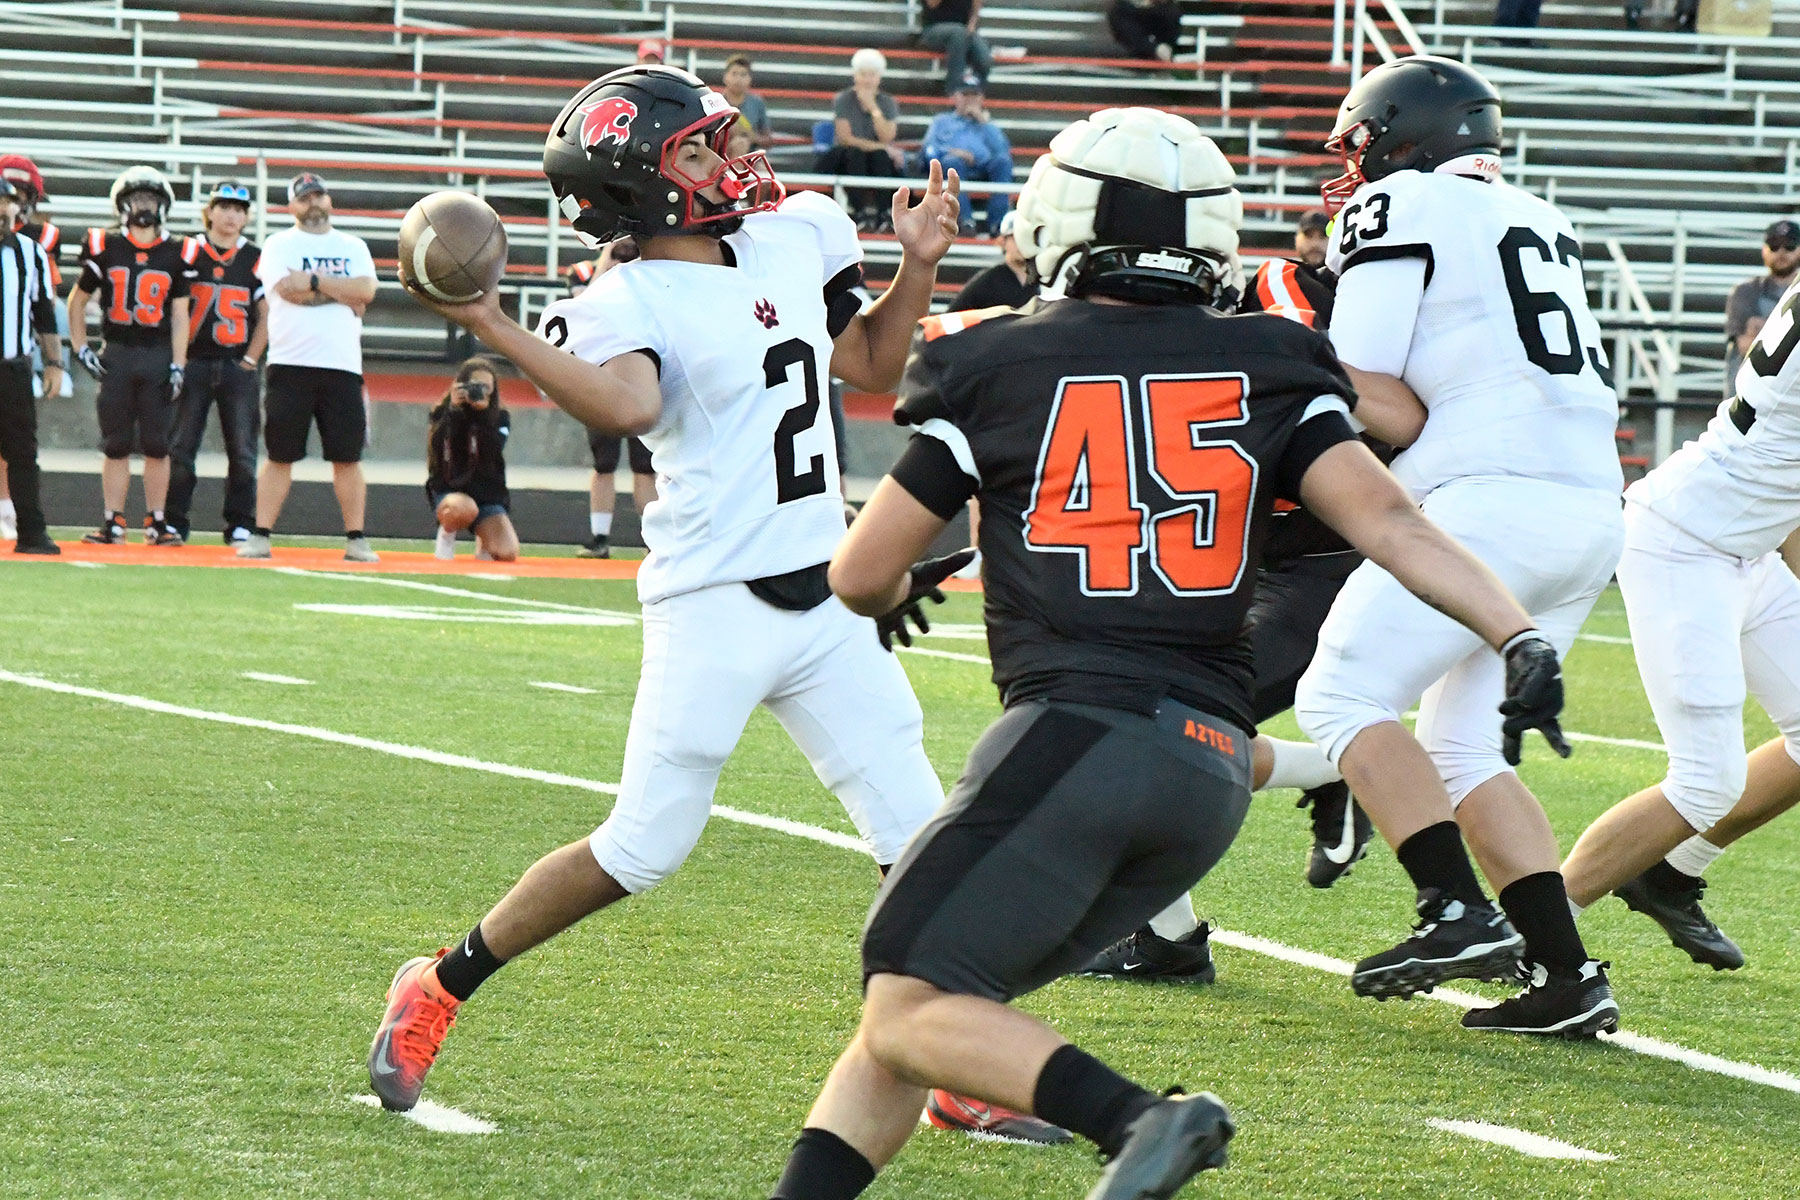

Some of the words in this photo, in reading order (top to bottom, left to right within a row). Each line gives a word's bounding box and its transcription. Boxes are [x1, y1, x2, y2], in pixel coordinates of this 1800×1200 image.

[1340, 192, 1391, 255] 63
[107, 266, 172, 327] 19
[189, 281, 250, 348] 75
[762, 337, 826, 505] 2
[1021, 371, 1259, 597] 45
[1184, 719, 1235, 756] AZTEC
